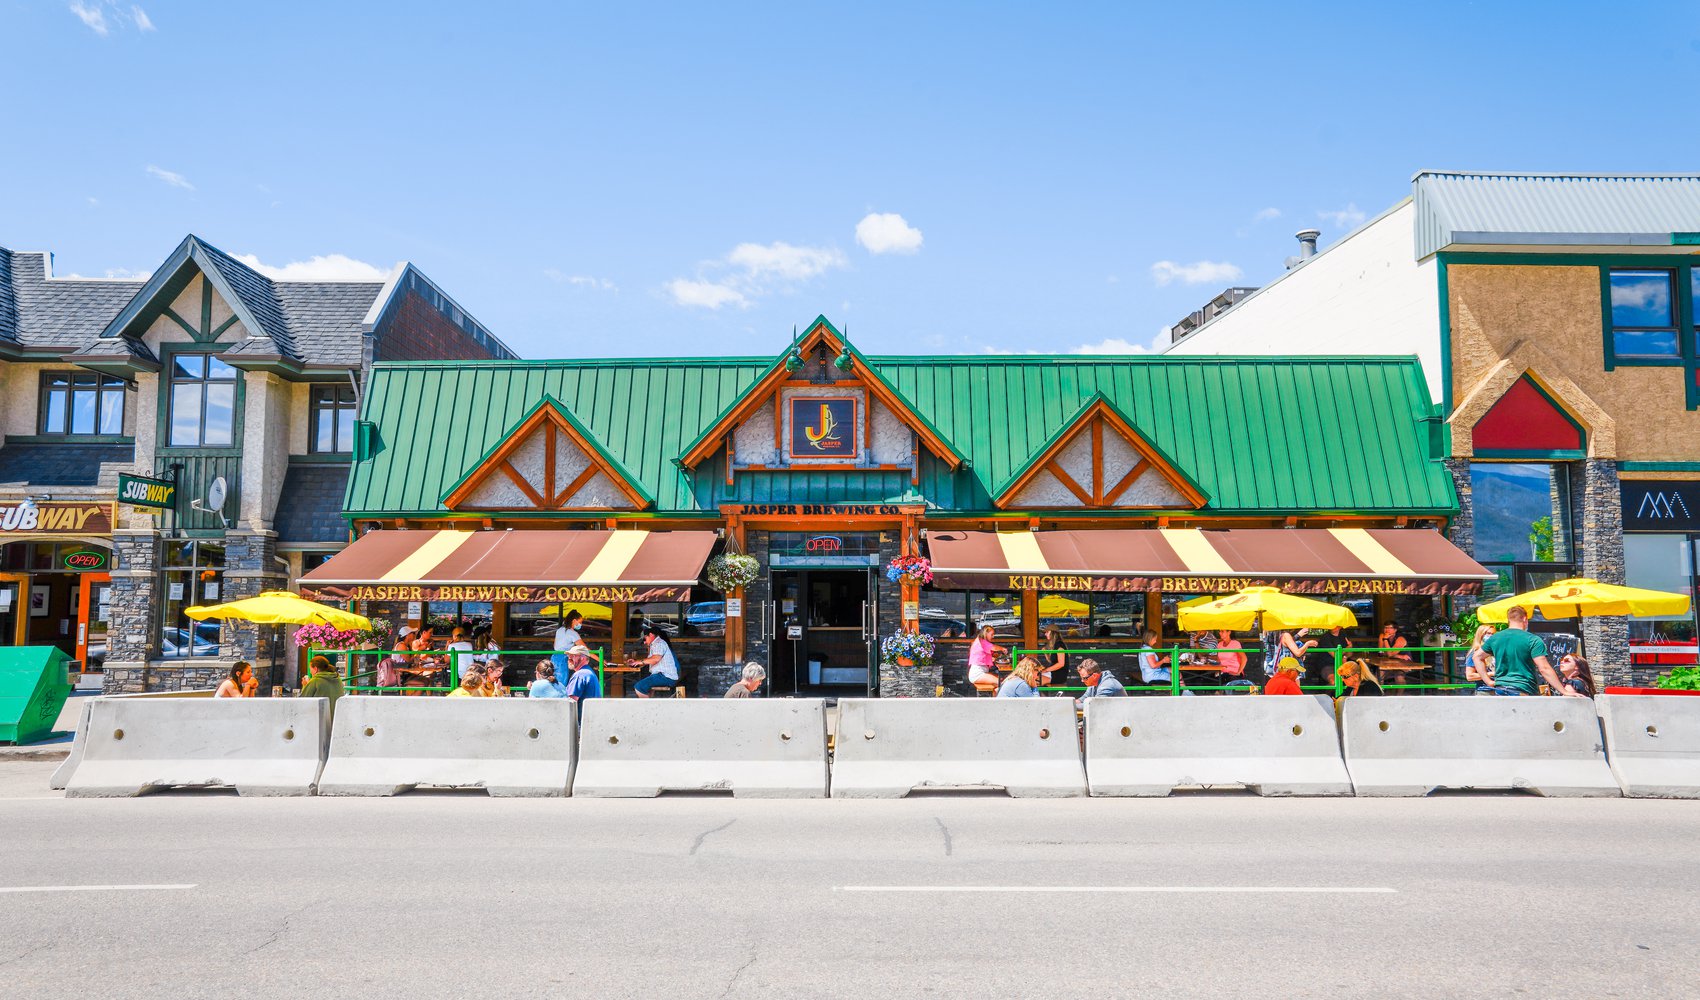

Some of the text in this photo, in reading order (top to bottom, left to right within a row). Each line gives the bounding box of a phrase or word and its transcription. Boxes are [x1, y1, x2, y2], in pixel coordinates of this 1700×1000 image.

[122, 481, 175, 503] SUBWAY
[741, 505, 903, 515] JASPER BREWING CO.
[806, 539, 840, 551] OPEN
[69, 555, 100, 566] OPEN
[1008, 576, 1407, 594] KITCHEN BREWERY APPAREL
[352, 586, 638, 601] JASPER BREWING COMPANY
